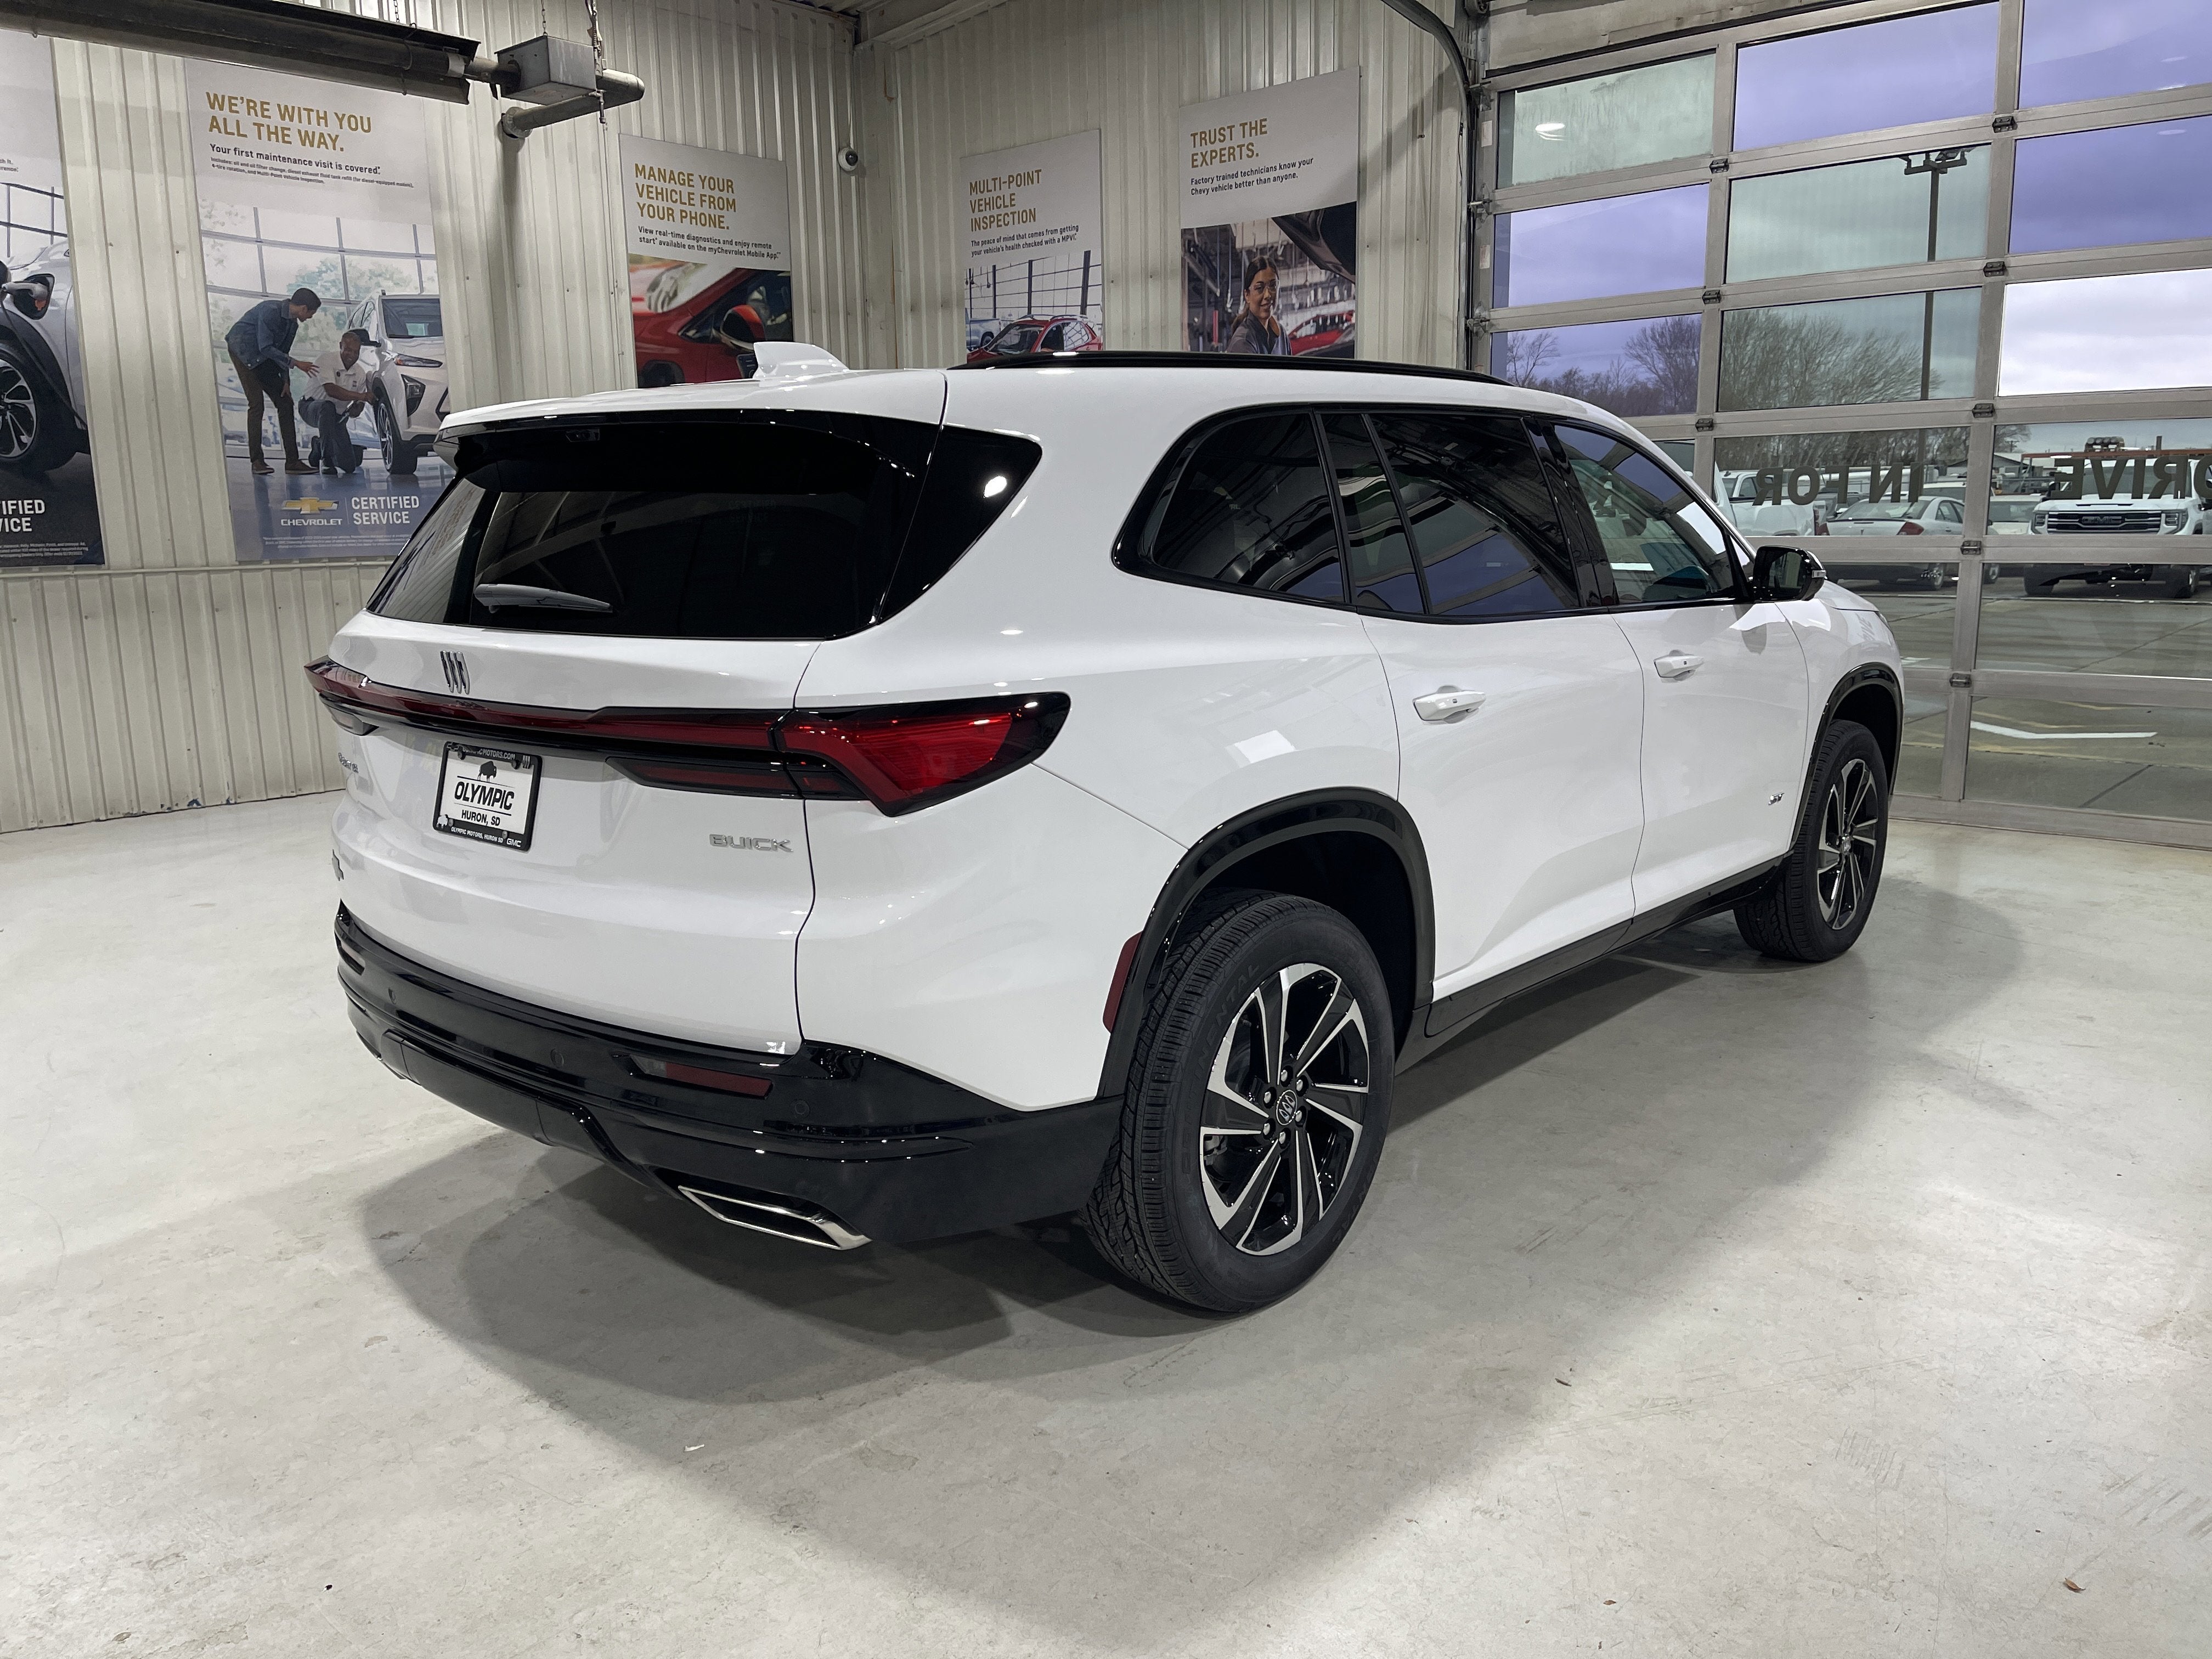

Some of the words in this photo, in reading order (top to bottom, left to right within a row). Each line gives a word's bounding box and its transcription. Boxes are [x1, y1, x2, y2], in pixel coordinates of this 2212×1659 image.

[277, 104, 329, 128] WITH
[334, 112, 372, 133] YOU
[208, 115, 248, 138] ALL
[253, 122, 292, 144] THE
[297, 129, 345, 152] WAY.
[1190, 125, 1235, 148] TRUST
[1239, 118, 1268, 138] THE
[210, 143, 231, 154] Your
[233, 147, 253, 159] first
[256, 153, 313, 166] maintenance
[315, 160, 334, 170] visit
[335, 161, 342, 170] is
[1191, 142, 1259, 168] EXPERTS.
[634, 163, 695, 188] MANAGE
[698, 174, 735, 194] YOUR
[969, 168, 1042, 196] MULTI-POINT
[1190, 176, 1215, 185] Factory
[1216, 171, 1239, 181] trained
[1240, 165, 1277, 177] technicians
[1278, 161, 1296, 171] know
[1297, 158, 1314, 169] your
[1190, 187, 1210, 196] Chevy
[1211, 183, 1233, 193] vehicle
[1234, 180, 1255, 189] better
[1256, 177, 1271, 185] than
[1272, 172, 1299, 183] anyone.
[635, 183, 696, 207] VEHICLE
[699, 193, 736, 212] FROM
[969, 193, 1016, 213] VEHICLE
[636, 202, 675, 222] YOUR
[680, 209, 730, 230] PHONE.
[970, 207, 1036, 232] INSPECTION
[638, 226, 654, 235] View
[655, 229, 685, 239] real-time
[687, 233, 721, 245] diagnostics
[723, 237, 733, 246] and
[735, 240, 751, 249] enjoy
[751, 241, 772, 250] remote
[981, 238, 995, 247] peace
[1003, 234, 1015, 242] mind
[1028, 230, 1045, 239] comes
[1046, 227, 1058, 235] from
[1059, 224, 1079, 235] getting
[659, 239, 686, 250] available
[696, 244, 707, 252] the
[708, 246, 746, 256] myChevrolet
[747, 249, 765, 258] Mobile
[971, 249, 982, 258] your
[983, 245, 1005, 255] vehicle's
[1005, 242, 1021, 252] health
[1022, 240, 1043, 249] checked
[1044, 238, 1056, 246] with
[0, 500, 46, 515] IFIED
[351, 495, 420, 510] CERTIFIED
[353, 511, 410, 524] SERVICE
[2081, 516, 2122, 524] GMC
[454, 781, 515, 810] OLYMPIC
[461, 810, 488, 825] HURON,
[490, 816, 500, 826] SD
[451, 826, 467, 834] OLYMPIC
[484, 834, 498, 842] HURON
[506, 838, 522, 848] GMC
[709, 834, 793, 853] BUICK
